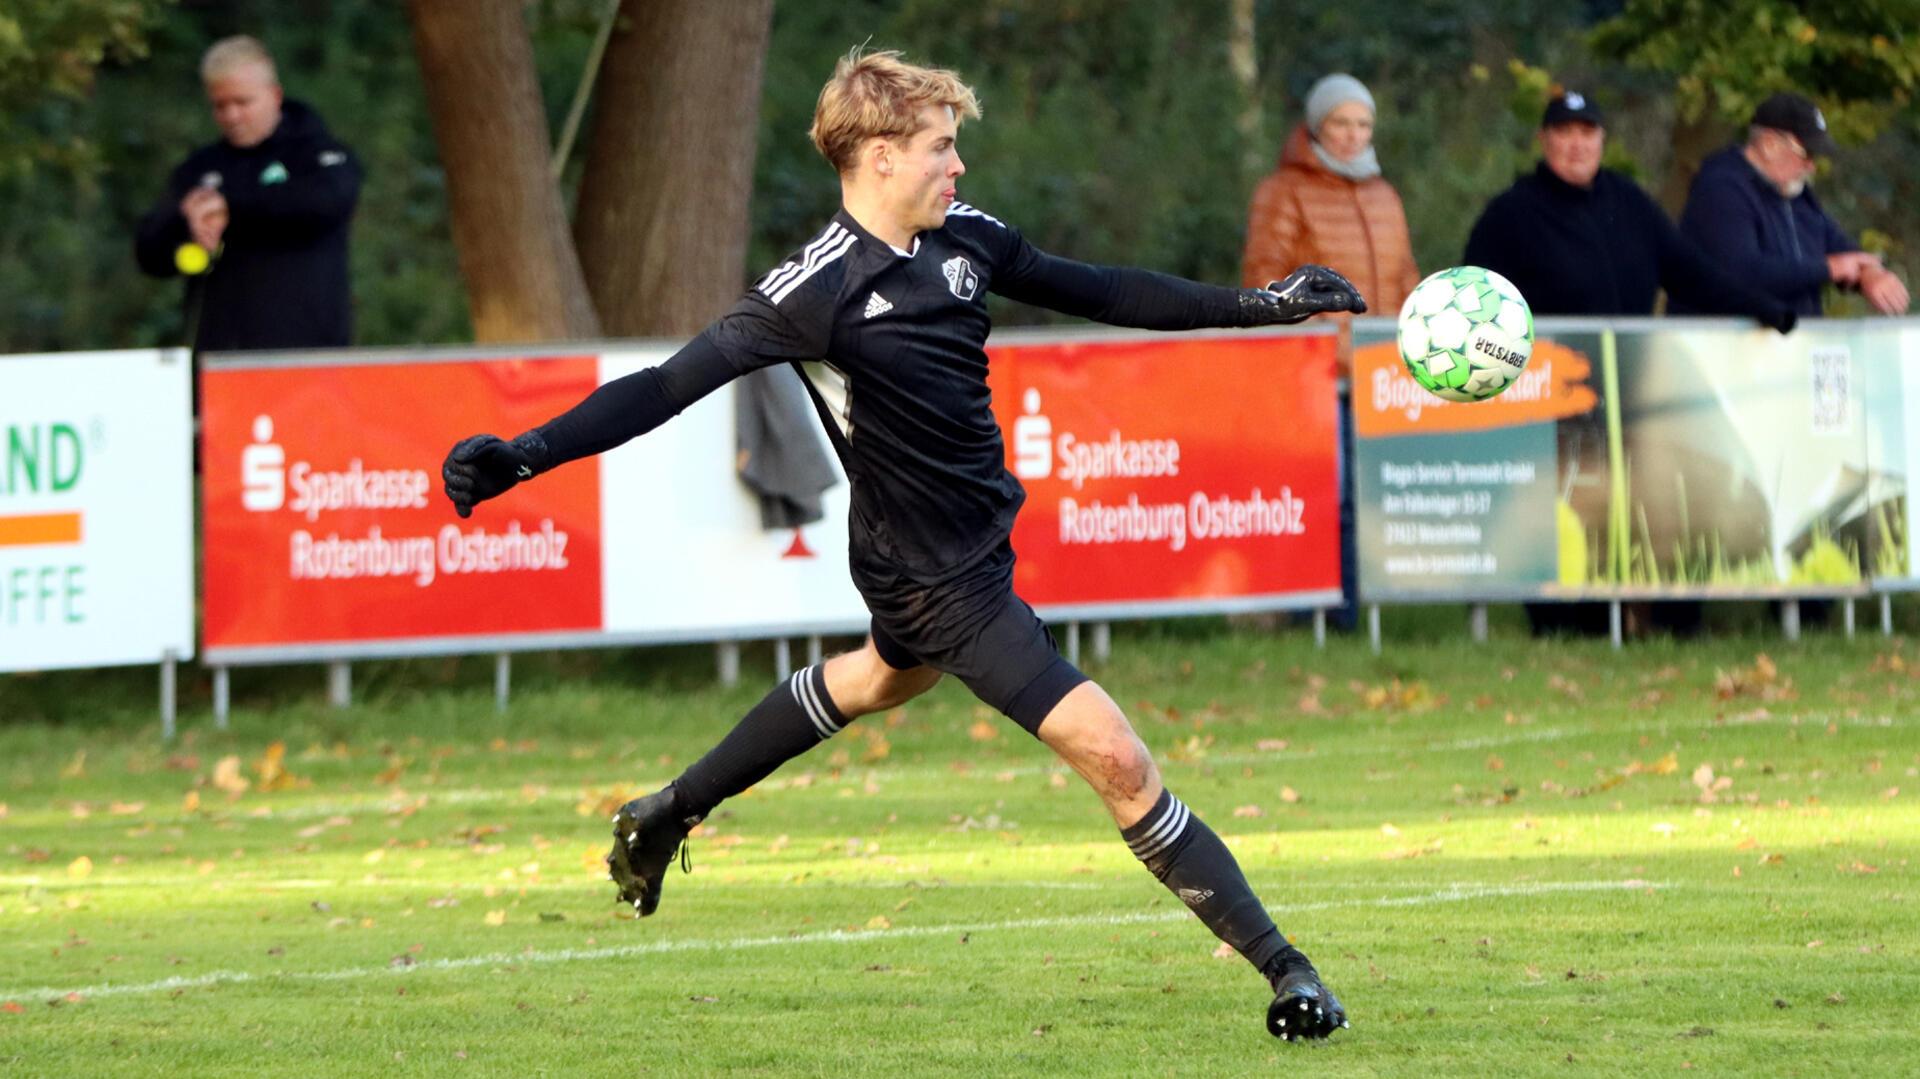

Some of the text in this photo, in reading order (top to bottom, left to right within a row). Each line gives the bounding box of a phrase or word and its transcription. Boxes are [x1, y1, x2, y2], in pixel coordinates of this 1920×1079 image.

[864, 301, 894, 319] adidas
[289, 457, 430, 522] Sparkasse
[1057, 428, 1180, 490] Sparkasse
[1059, 485, 1306, 552] Rotenburg Osterholz
[290, 518, 569, 587] Rotenburg Osterholz
[0, 565, 86, 624] FFE
